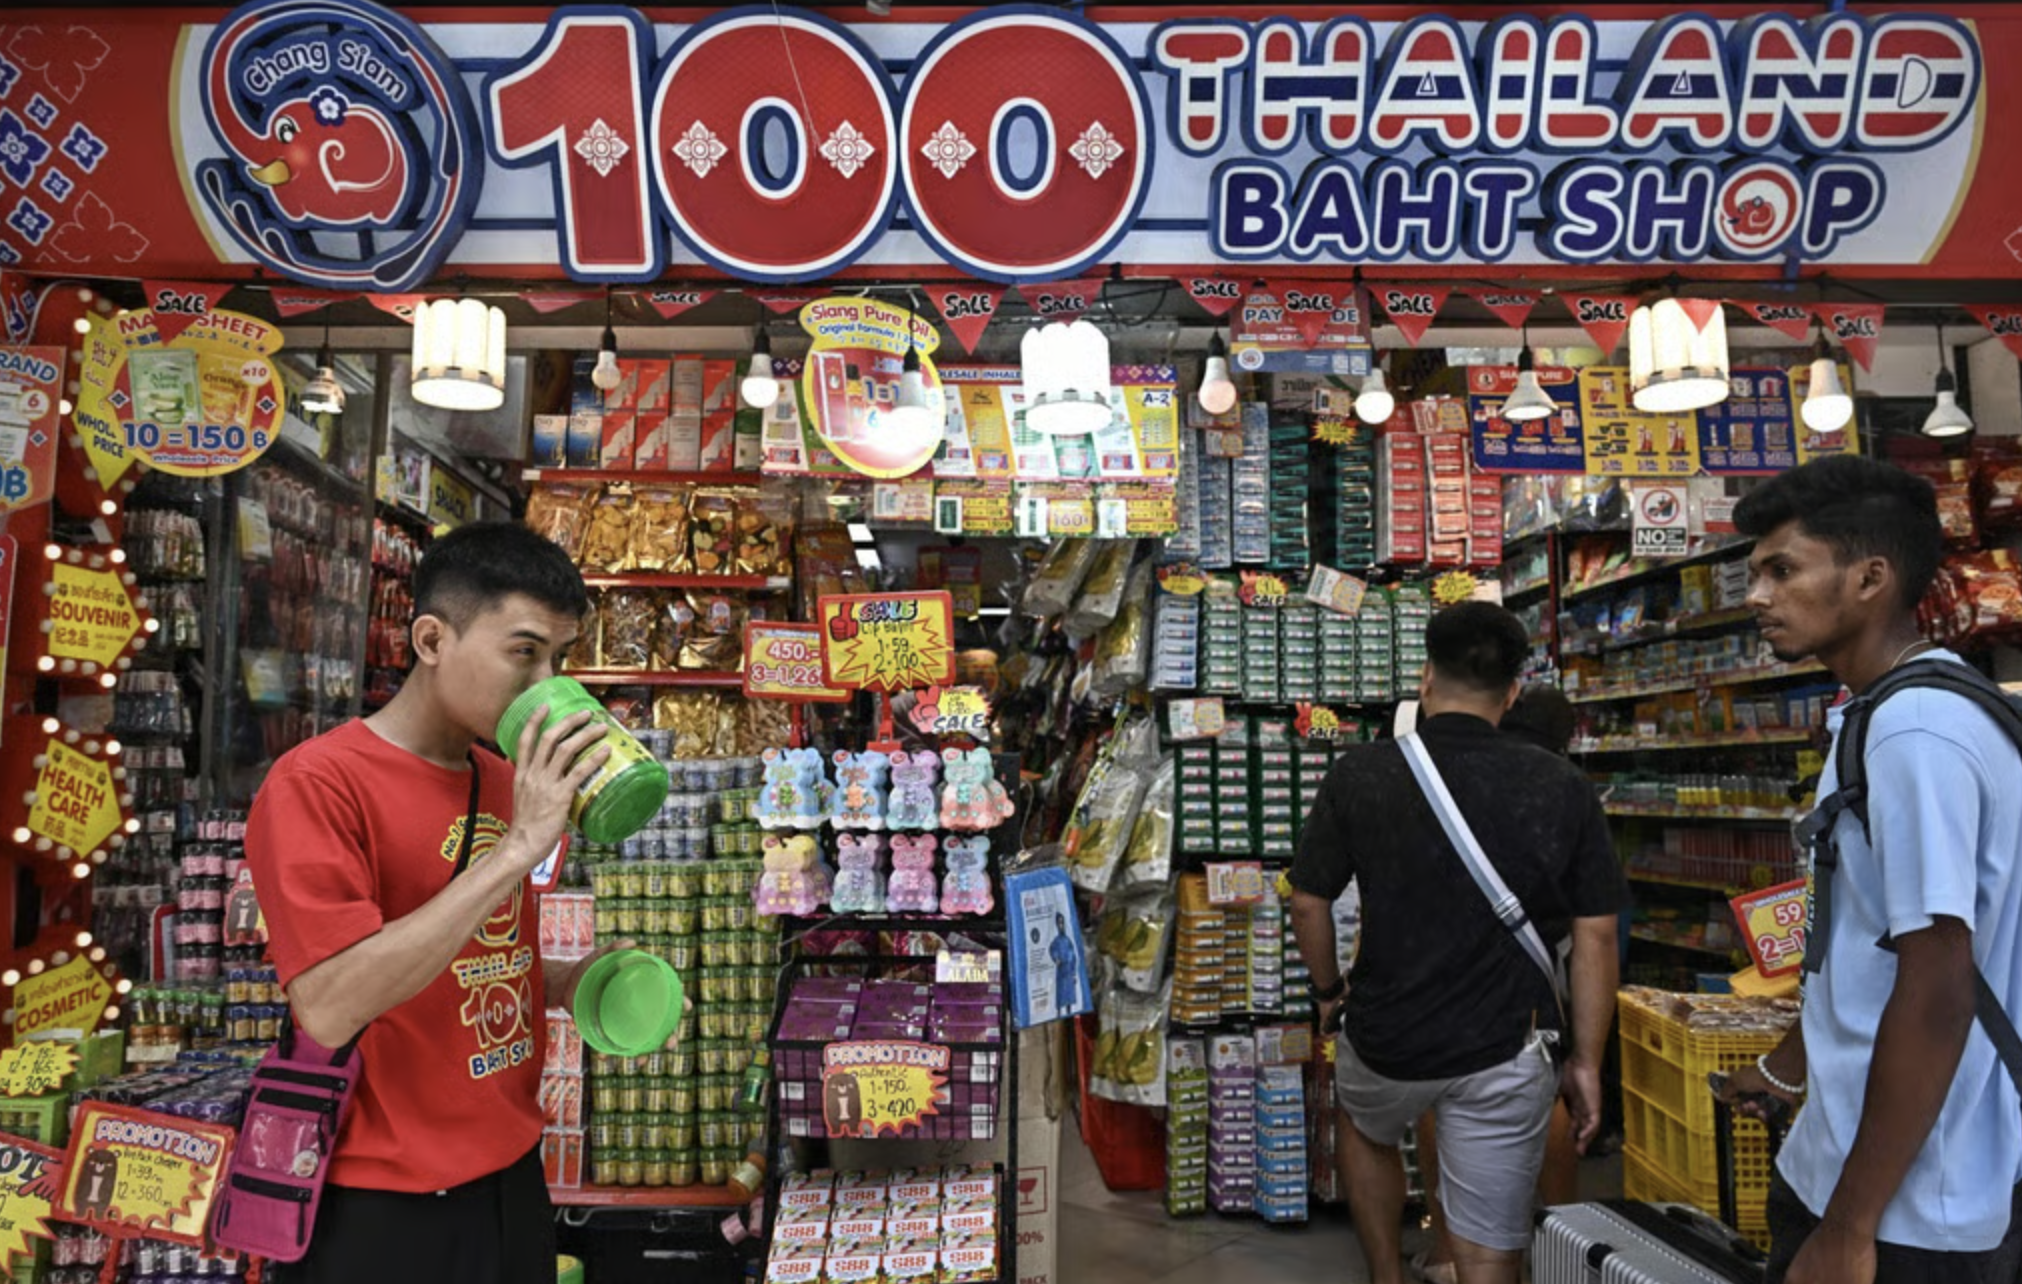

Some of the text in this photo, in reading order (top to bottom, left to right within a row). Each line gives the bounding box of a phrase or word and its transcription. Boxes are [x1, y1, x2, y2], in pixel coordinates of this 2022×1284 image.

[338, 40, 407, 102] Siam
[1155, 18, 1977, 150] THAILAND
[488, 12, 1150, 277] 100
[1219, 161, 1883, 260] BAHT SHOP
[1192, 279, 1239, 298] SALE
[1286, 290, 1334, 311] SALE
[155, 290, 206, 314] SALE
[944, 293, 992, 318] SALE
[1039, 295, 1087, 313] SALE
[1387, 292, 1435, 315] SALE
[1578, 299, 1627, 325] SALE
[1758, 304, 1807, 322] SALE
[119, 313, 154, 334] MA
[196, 311, 270, 340] SHEET
[863, 304, 903, 326] Pure
[906, 318, 930, 338] Oil
[1243, 308, 1283, 324] PAY
[1833, 314, 1878, 339] SALE
[982, 369, 1022, 381] INHALE
[1499, 370, 1519, 380] SIA
[27, 394, 40, 408] 6
[1142, 392, 1170, 405] A-2
[122, 422, 160, 447] 10
[93, 435, 125, 459] PRICE
[1637, 529, 1666, 545] NO
[51, 598, 132, 630] SOUVENIR
[858, 600, 918, 623] SALE
[933, 713, 984, 733] SALE
[42, 763, 106, 811] HEALTH
[47, 791, 91, 826] CARE
[1774, 900, 1803, 926] 59
[14, 981, 102, 1035] COSMETIC
[826, 1045, 946, 1068] PROMOTION
[95, 1119, 218, 1166] PROMOTION
